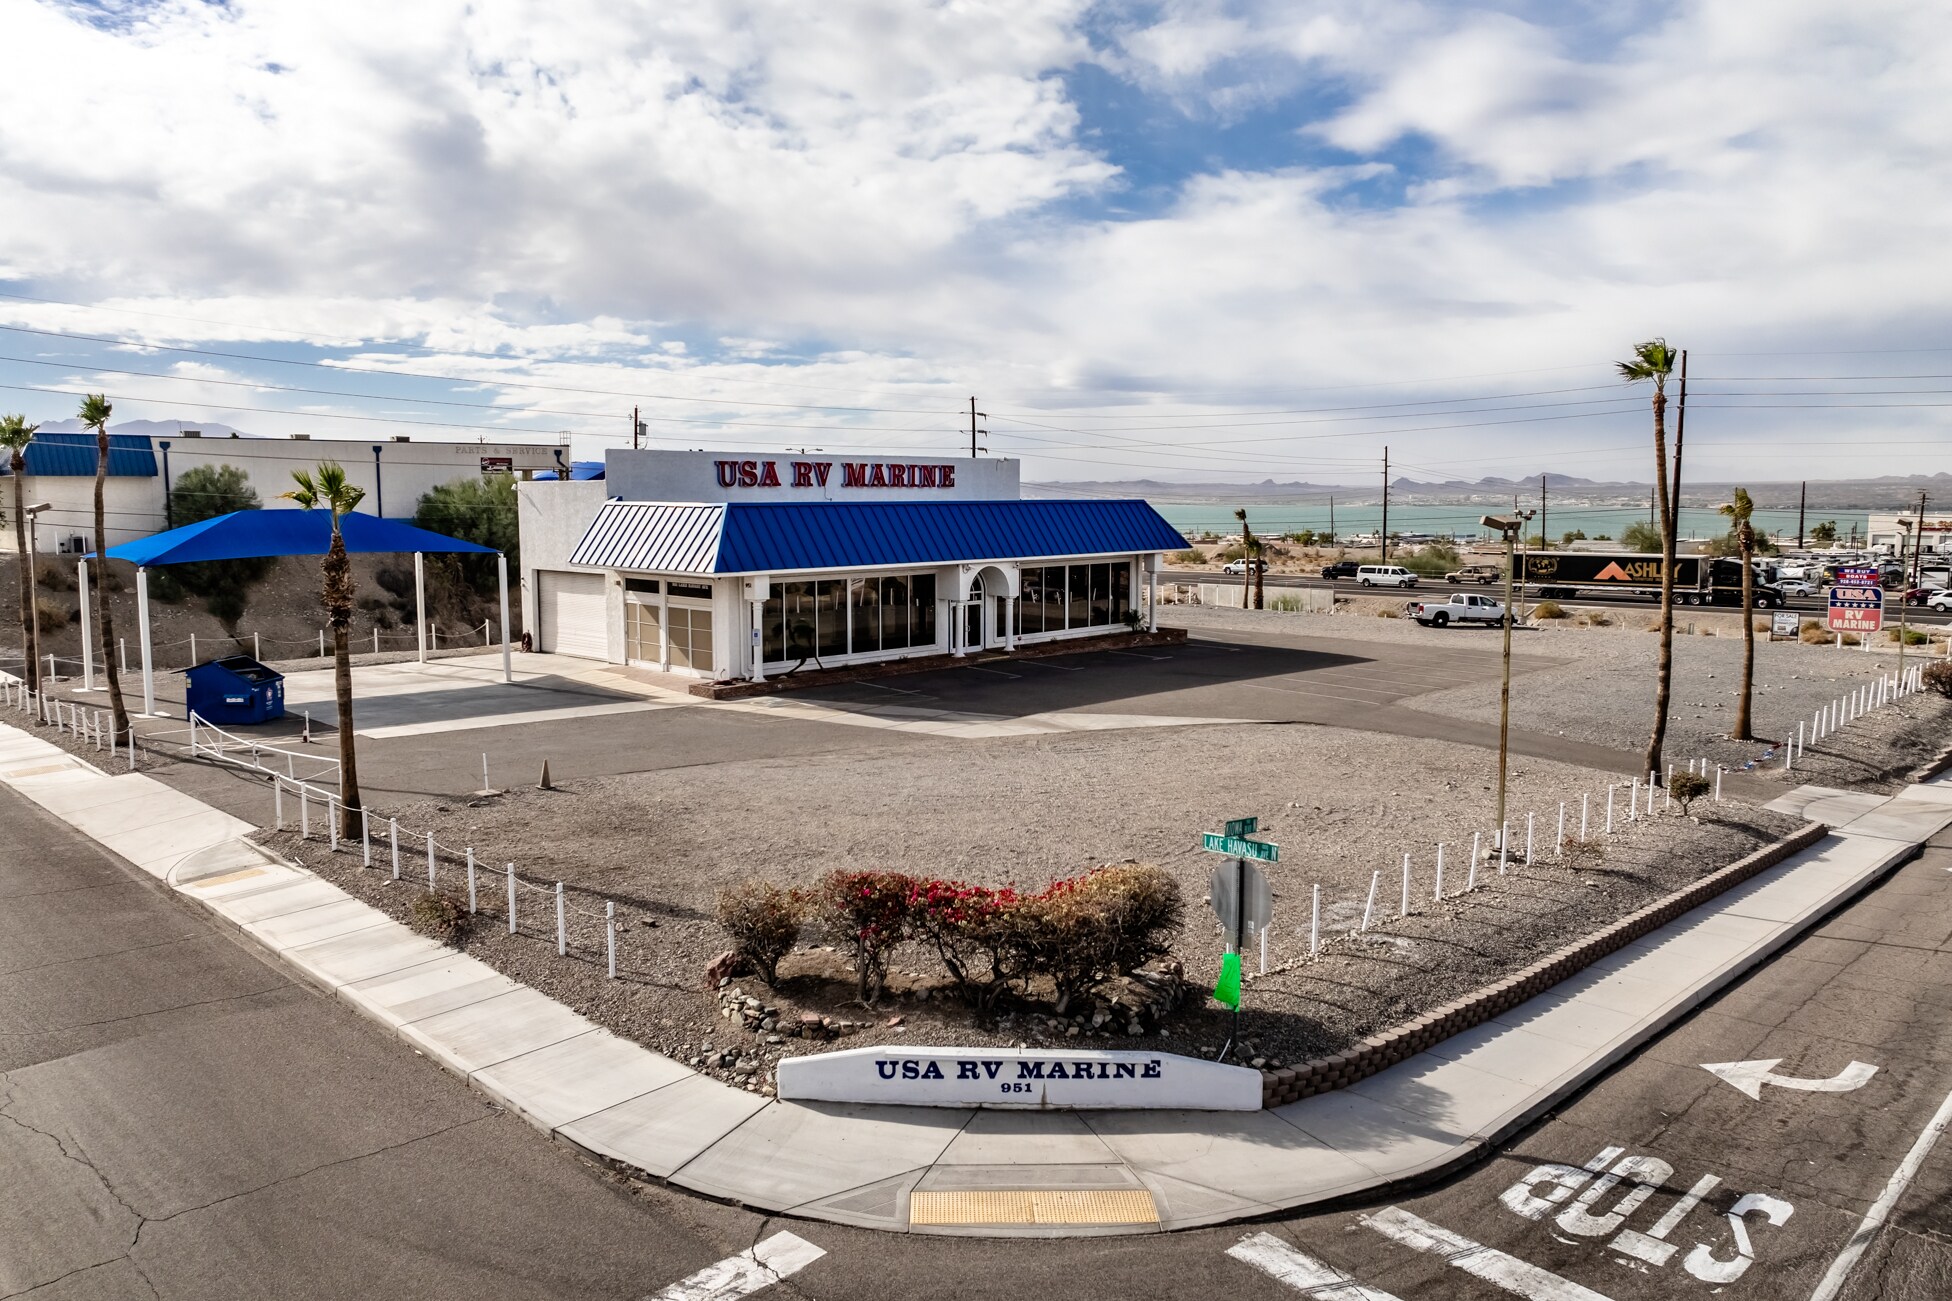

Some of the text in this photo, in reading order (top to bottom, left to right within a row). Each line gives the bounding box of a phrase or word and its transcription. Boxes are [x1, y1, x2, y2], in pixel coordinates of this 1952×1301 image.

[455, 446, 488, 454] PARTS
[506, 447, 548, 455] SERVICE
[714, 460, 956, 488] USA RV MARINE
[1835, 588, 1878, 601] USA
[1844, 610, 1865, 620] RV
[1833, 619, 1876, 630] MARINE
[1204, 835, 1277, 861] LAKE HAVASU AVE N
[875, 1059, 1161, 1080] USA RV MARINE
[1000, 1083, 1033, 1093] 951
[1499, 1145, 1794, 1284] STOP
